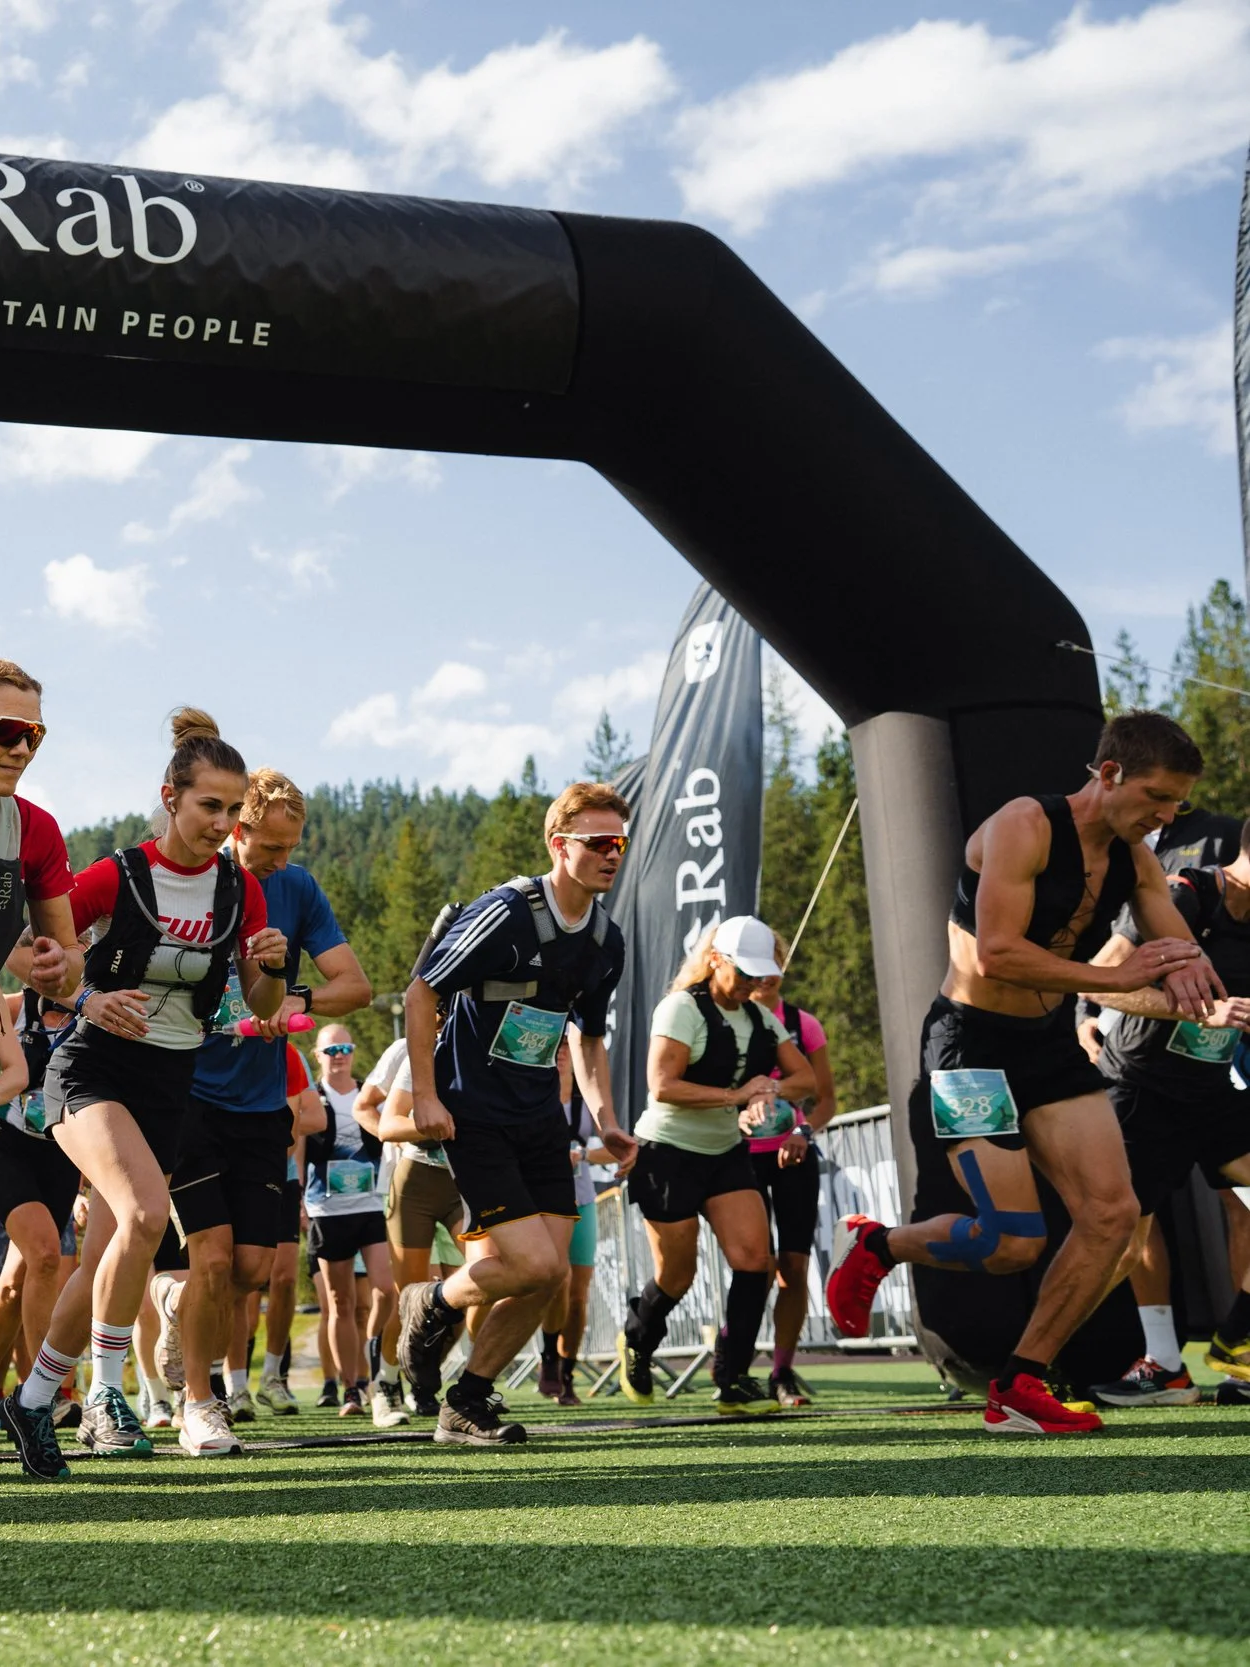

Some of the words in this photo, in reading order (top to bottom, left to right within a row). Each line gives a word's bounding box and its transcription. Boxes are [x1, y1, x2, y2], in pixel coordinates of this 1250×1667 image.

[121, 311, 271, 346] PEOPLE
[674, 767, 726, 911] Rab
[0, 872, 13, 899] Rab
[110, 949, 124, 974] SILVA
[517, 1031, 549, 1050] 484
[947, 1096, 992, 1118] 328
